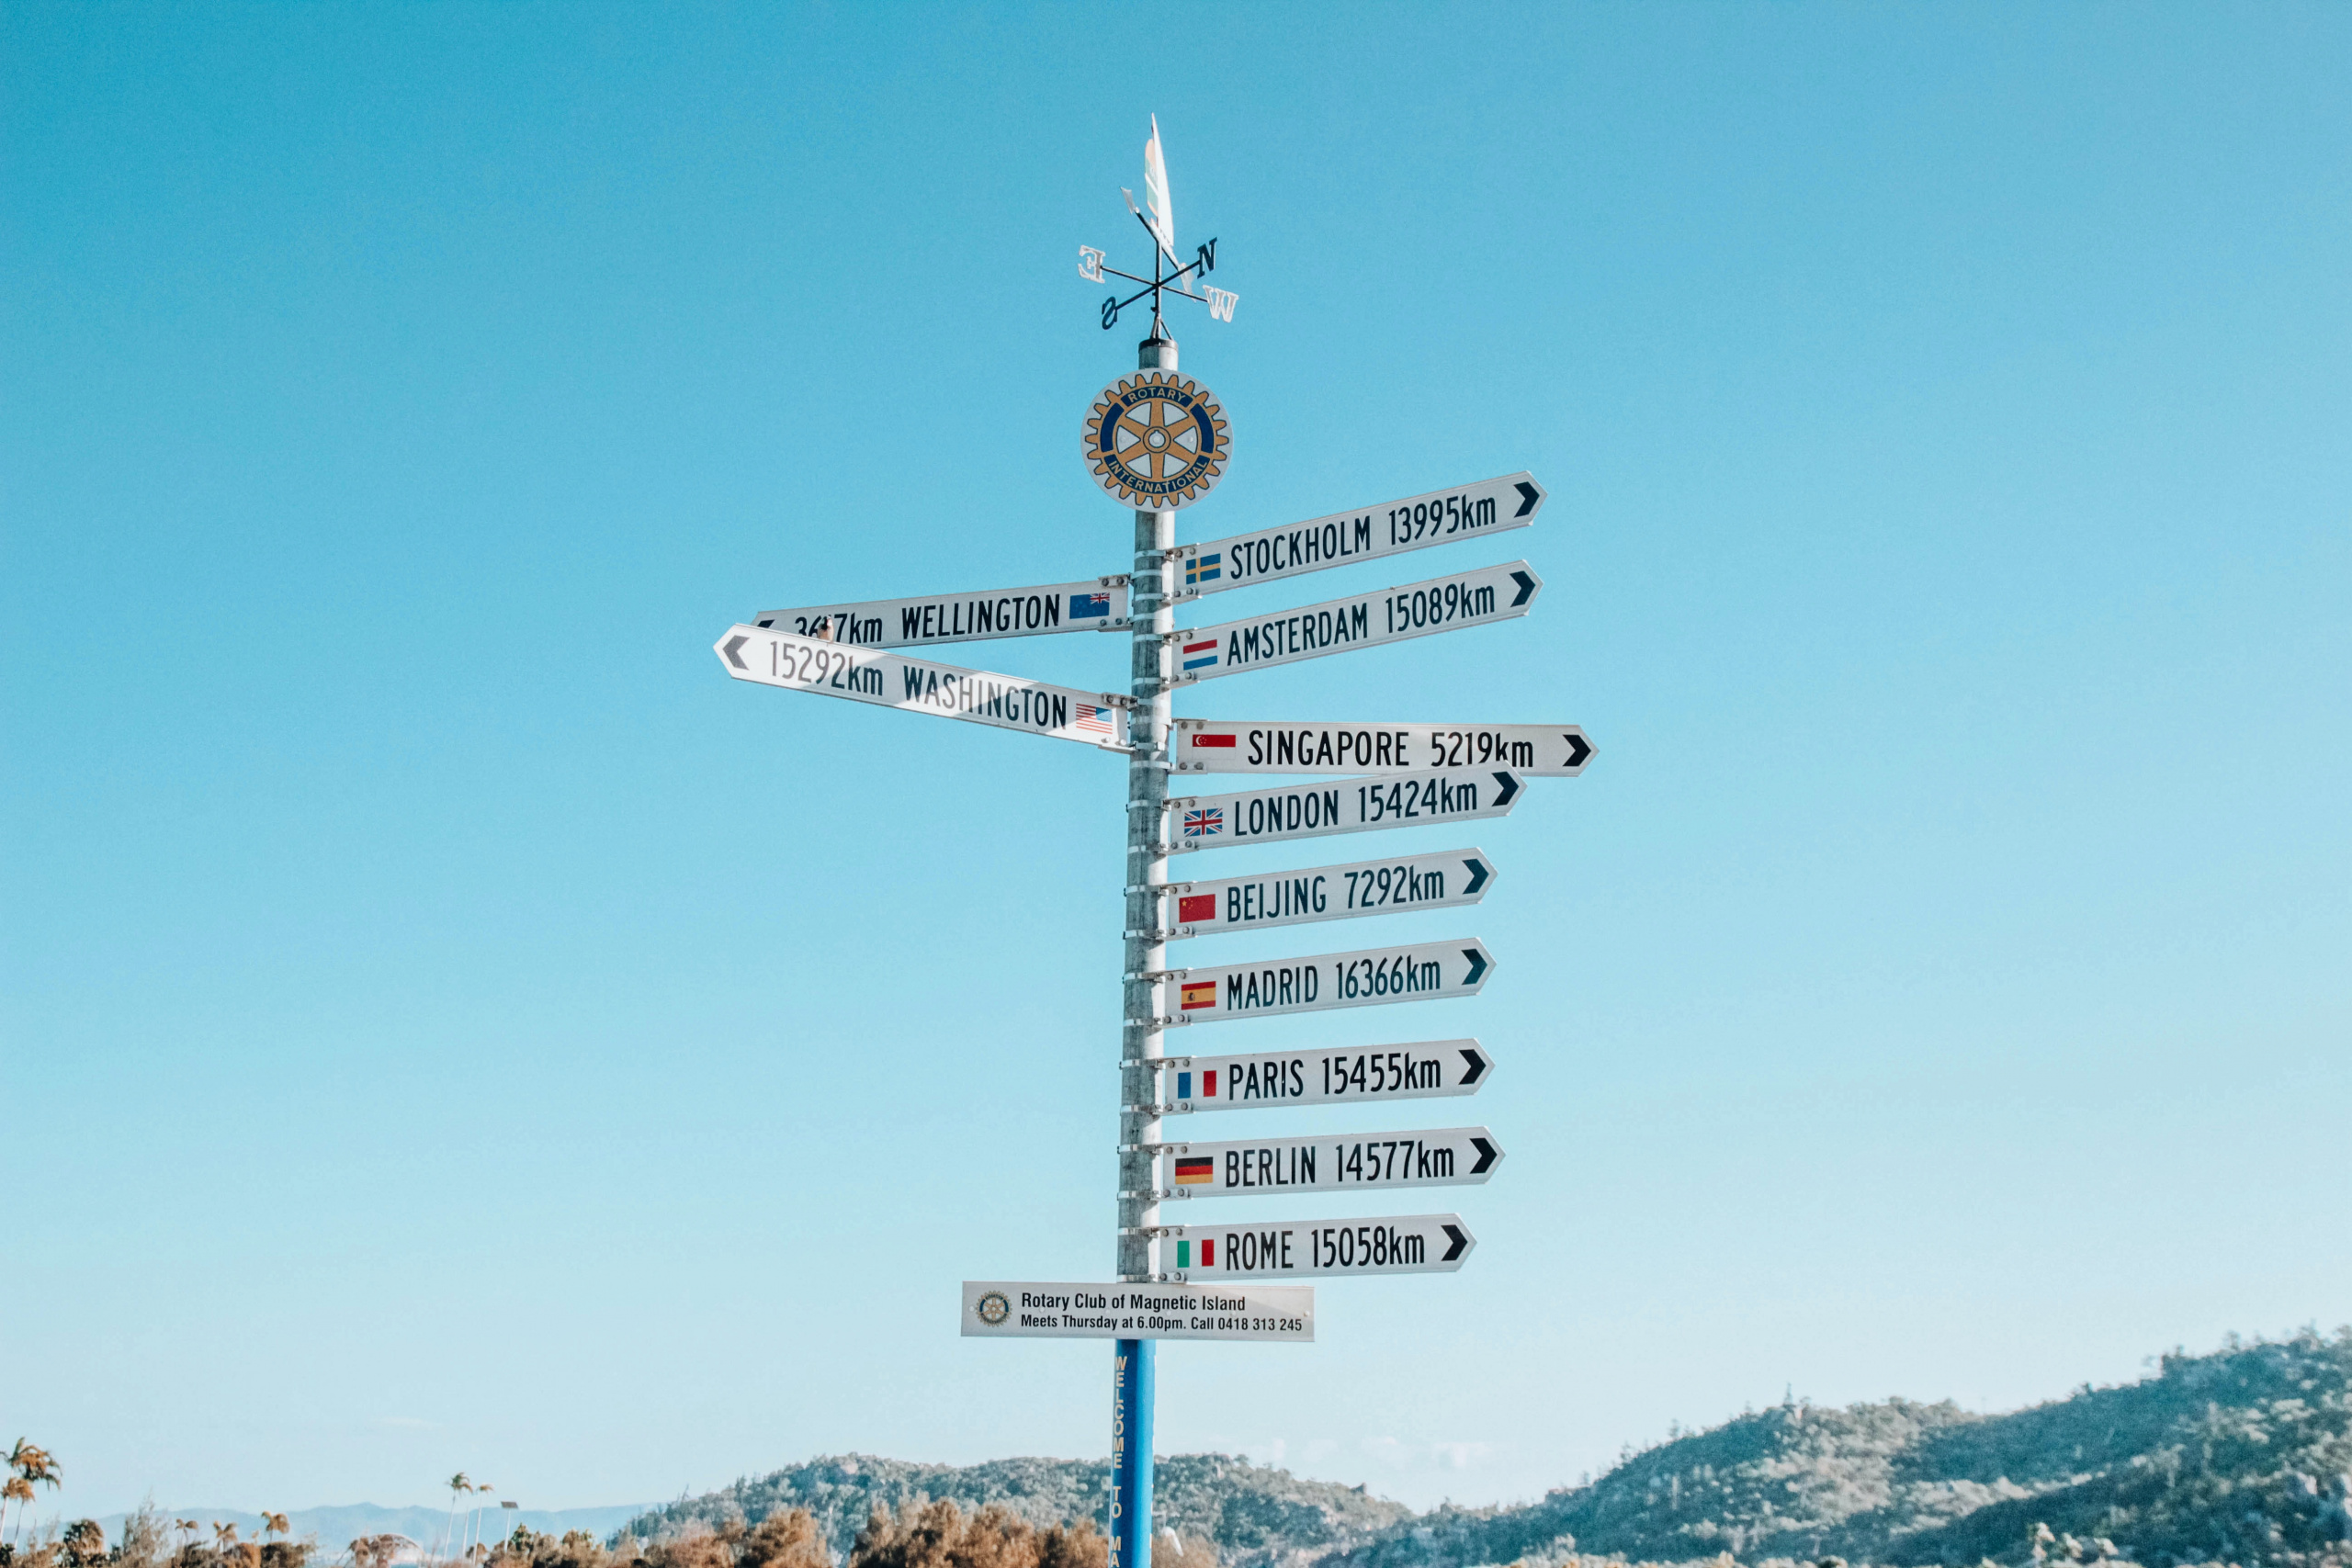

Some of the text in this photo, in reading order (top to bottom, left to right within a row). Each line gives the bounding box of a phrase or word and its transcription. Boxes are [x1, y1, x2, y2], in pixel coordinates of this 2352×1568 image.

[1197, 236, 1217, 279] N
[1203, 284, 1238, 322] W
[1127, 387, 1186, 402] ROTARY
[1108, 460, 1207, 493] INTERNATIONAL
[1230, 494, 1496, 580] STOCKHOLM 13995km
[795, 593, 1060, 644] 367km WELLINGTON
[1227, 581, 1495, 666] AMSTERDAM 15089km
[769, 640, 1067, 730] 15292km WASHINGTON
[1248, 729, 1533, 767] SINGAPORE 5219km
[1235, 776, 1477, 836] LONDON 15424km
[1227, 864, 1444, 923] BEIJING 7292km
[1227, 954, 1441, 1010] MADRID 16366km
[1228, 1052, 1442, 1100] PARIS 15455km
[1226, 1139, 1454, 1188] BERLIN 14577km
[1227, 1225, 1425, 1270] ROME 15058km
[1021, 1314, 1057, 1327] Meets
[1062, 1314, 1118, 1331] Thursday
[1122, 1316, 1133, 1328] at
[1137, 1316, 1186, 1332] 6.00pm.
[1191, 1316, 1214, 1330] Call
[1218, 1317, 1249, 1330] 0418
[1252, 1318, 1275, 1331] 313
[1280, 1318, 1302, 1331] 245
[1022, 1292, 1246, 1313] Rotary Club of Magnetic Island
[1114, 1356, 1127, 1469] WELCOME
[1112, 1485, 1122, 1518] TO
